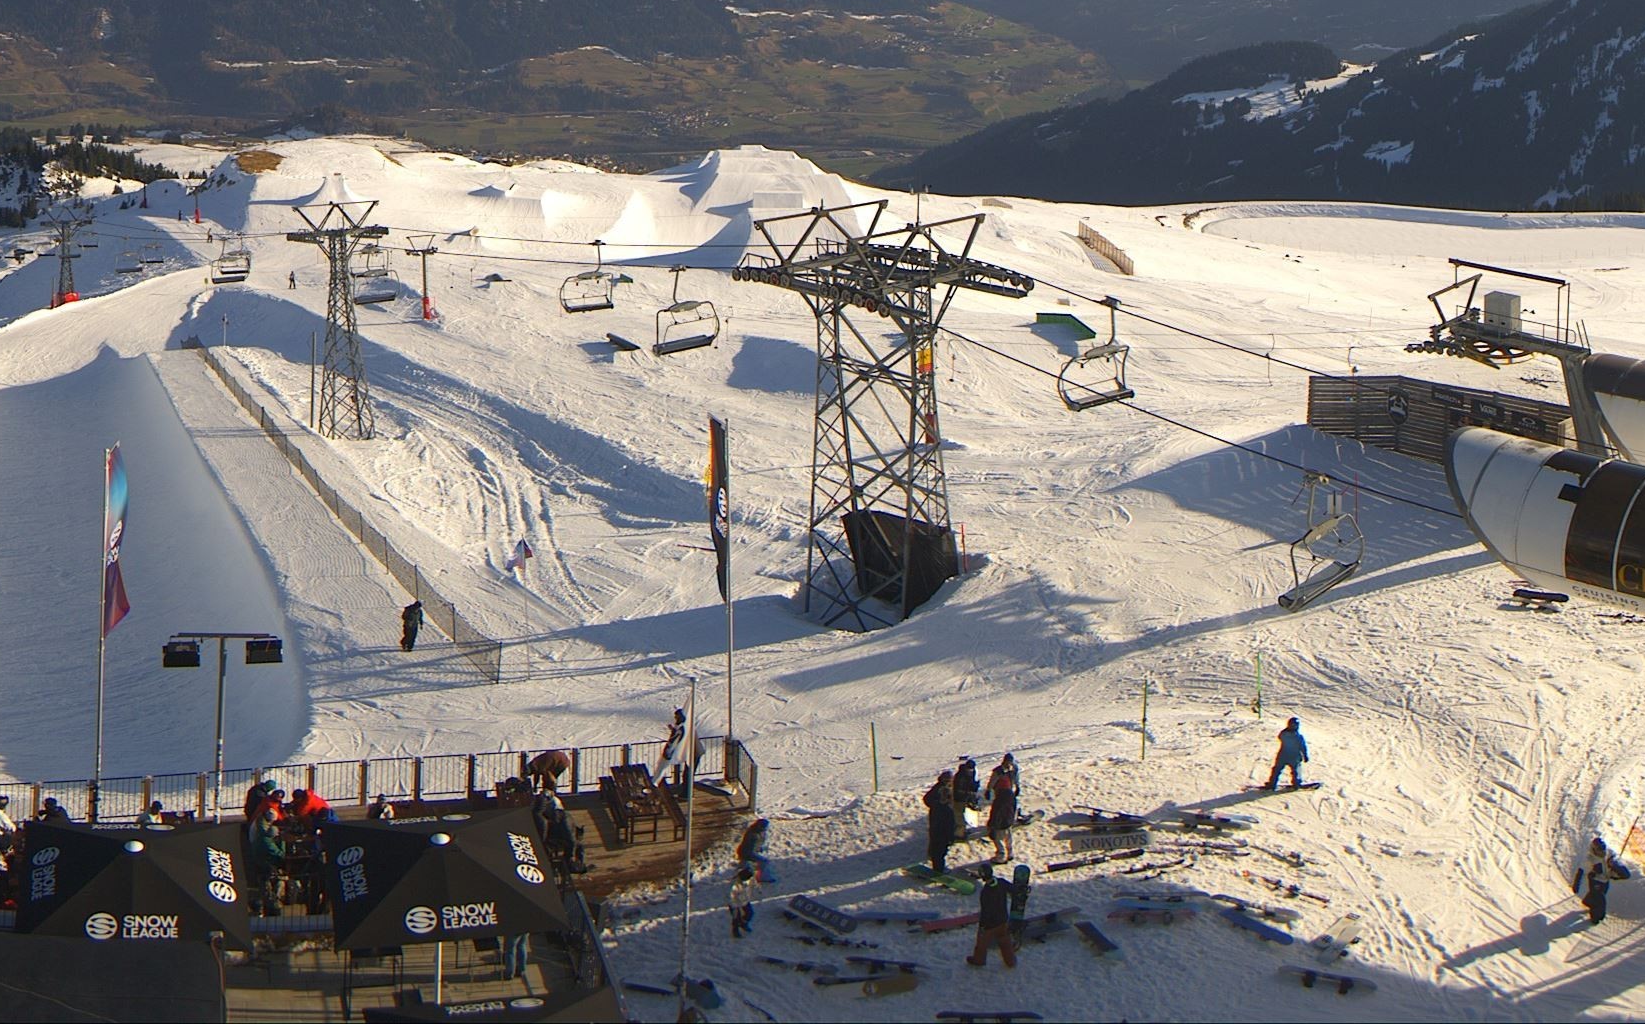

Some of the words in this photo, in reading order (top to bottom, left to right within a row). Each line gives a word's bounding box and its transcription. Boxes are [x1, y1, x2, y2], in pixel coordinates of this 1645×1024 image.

[1571, 585, 1640, 607] CRUISING
[506, 831, 528, 861] SNOW
[519, 835, 538, 865] LEAGUE
[1080, 833, 1148, 850] SALOMON
[207, 846, 223, 879] SNOW
[219, 850, 234, 883] LEAGUE
[441, 902, 496, 919] SNOW
[123, 915, 179, 927] SNOW
[443, 913, 498, 930] LEAGUE
[123, 927, 179, 939] LEAGUE
